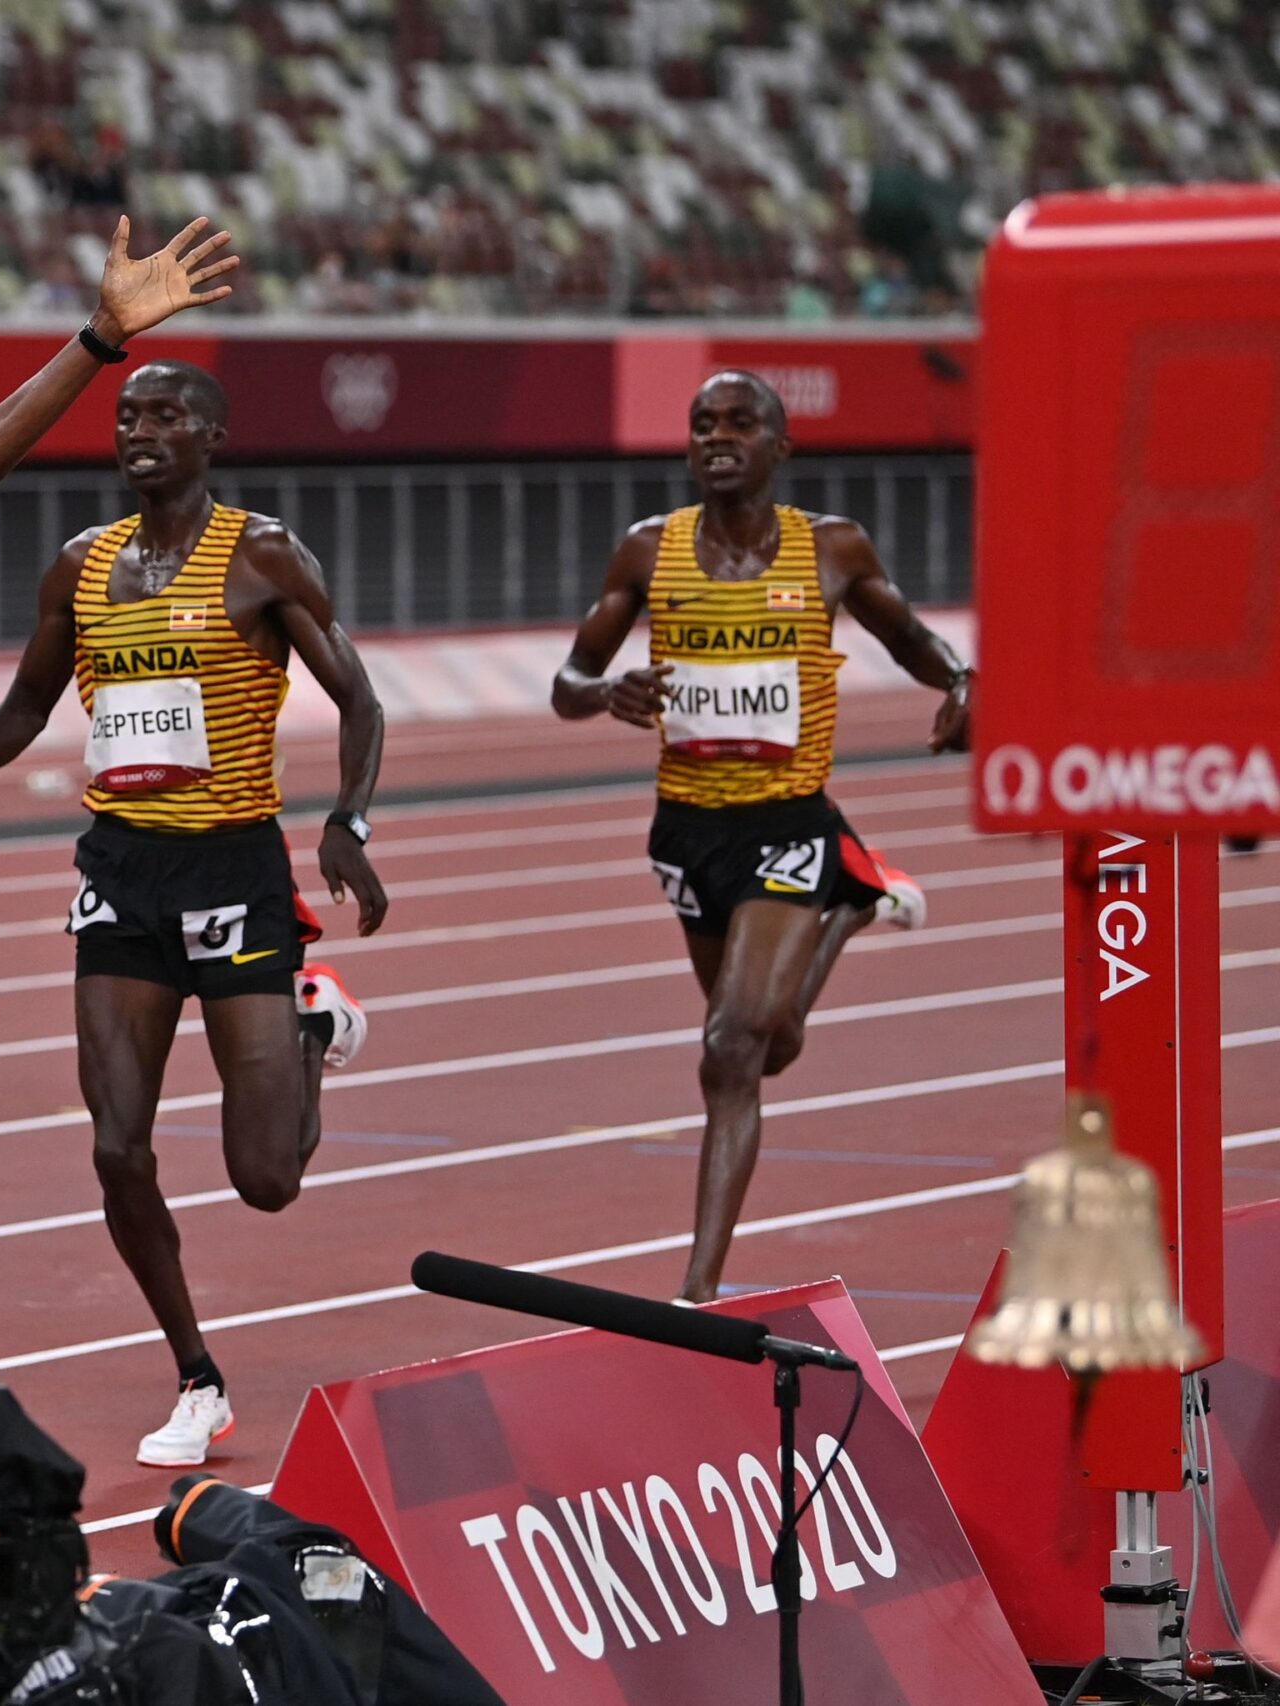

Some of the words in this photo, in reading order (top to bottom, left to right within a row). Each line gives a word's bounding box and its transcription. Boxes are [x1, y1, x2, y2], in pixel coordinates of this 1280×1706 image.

[668, 626, 797, 650] UGANDA
[93, 646, 200, 675] GANDA
[669, 683, 789, 716] KIPLIMO
[1050, 744, 1280, 814] OMEGA
[761, 841, 816, 885] 22
[199, 915, 230, 949] 6
[460, 1474, 728, 1673] TOKYO
[697, 1433, 897, 1615] 2020
